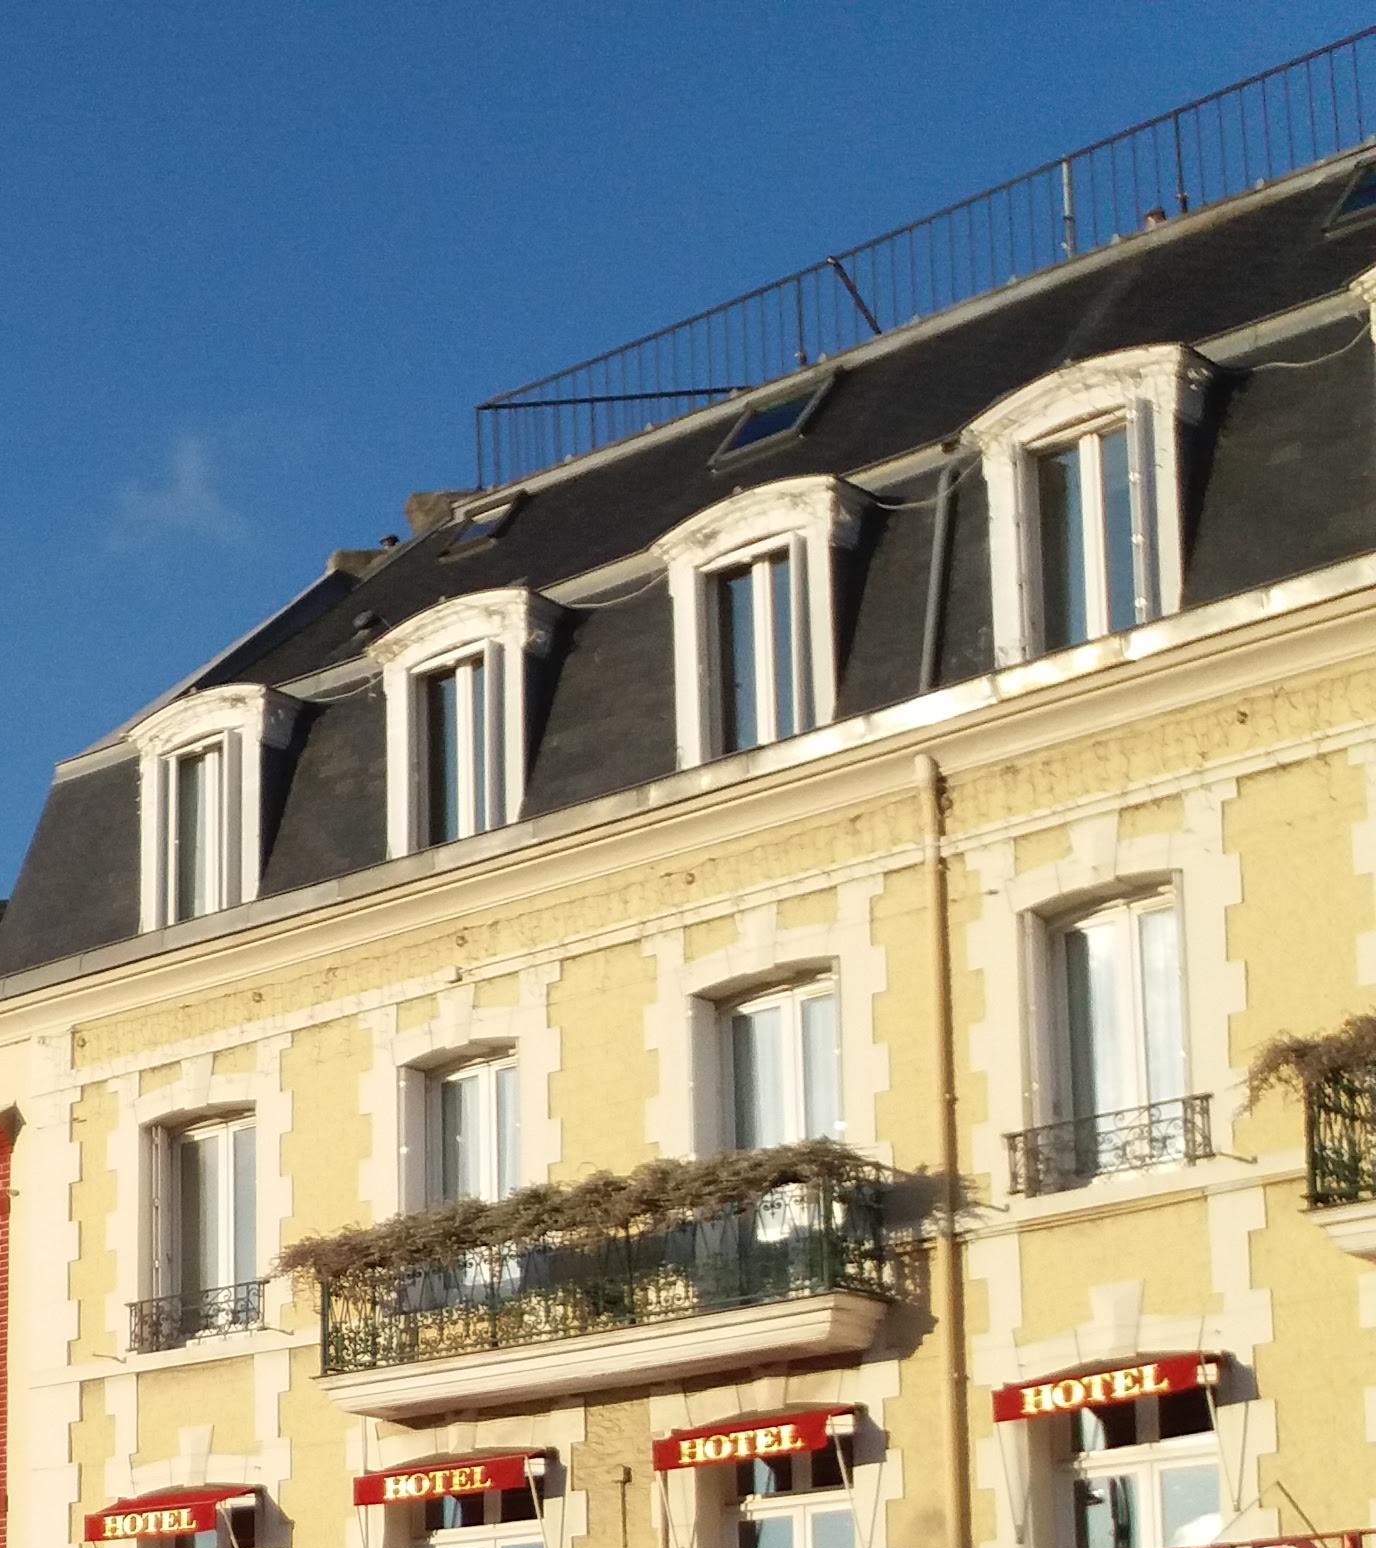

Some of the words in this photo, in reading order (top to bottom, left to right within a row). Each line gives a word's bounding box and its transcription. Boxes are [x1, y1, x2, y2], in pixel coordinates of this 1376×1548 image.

[1020, 1362, 1168, 1415] HOTEL
[676, 1423, 804, 1462] HOTEL
[383, 1463, 492, 1500] HOTEL
[103, 1507, 197, 1538] HOTEL
